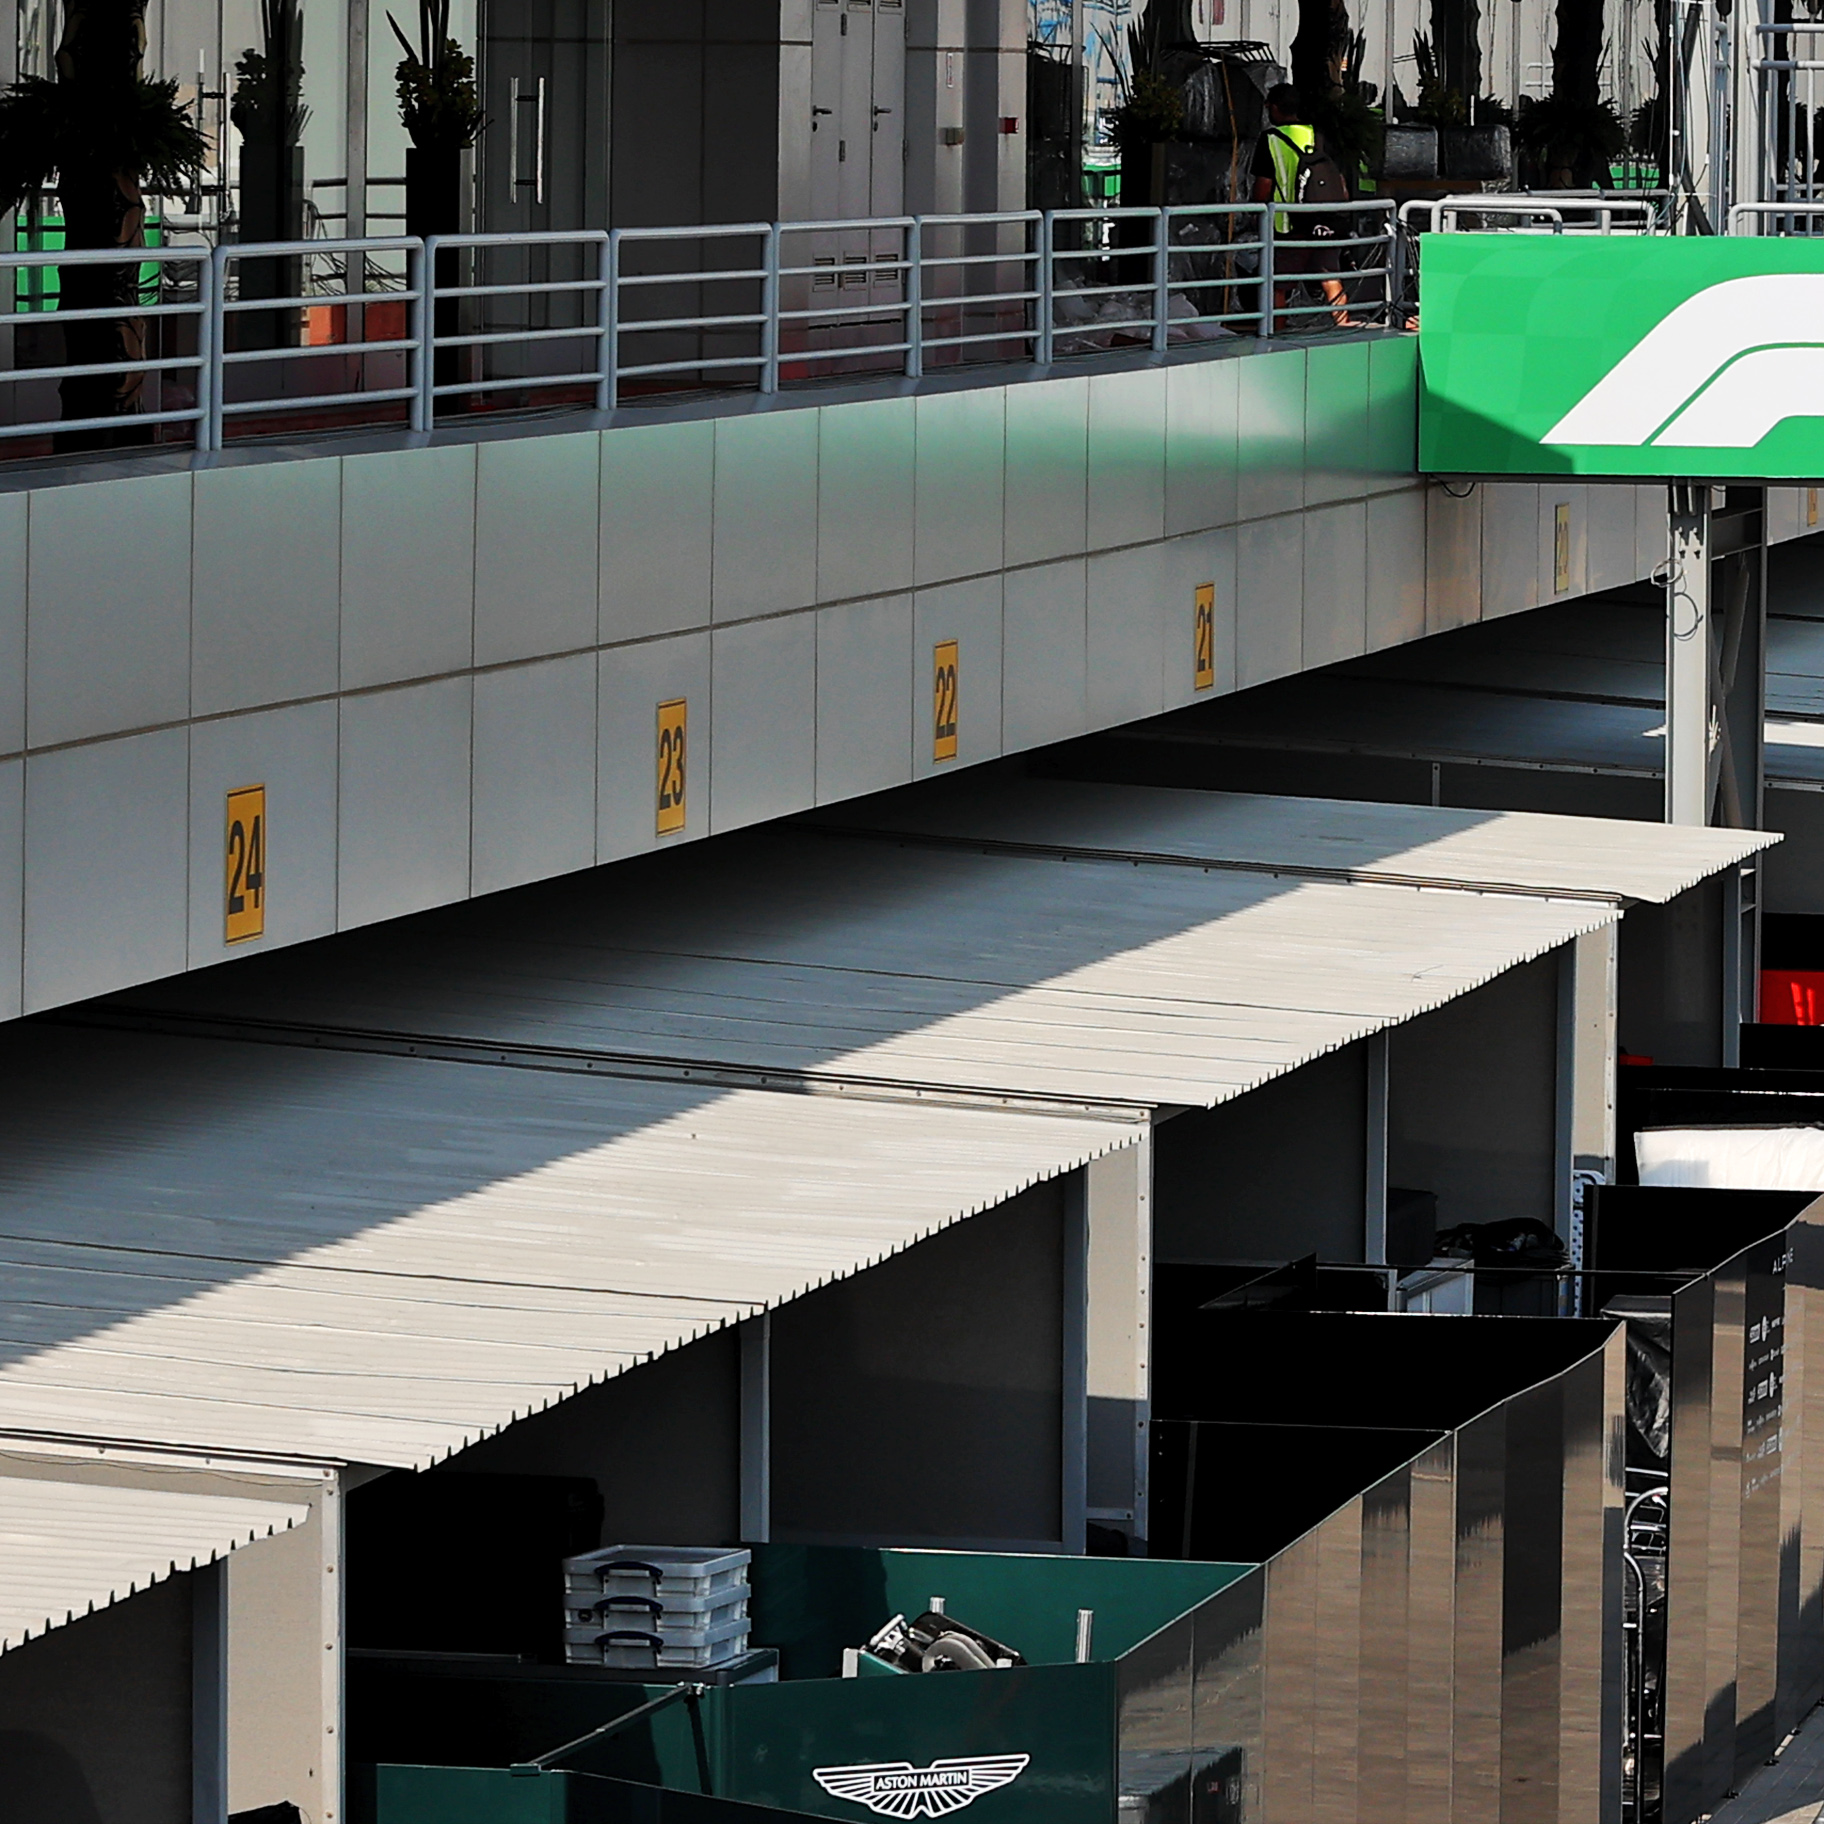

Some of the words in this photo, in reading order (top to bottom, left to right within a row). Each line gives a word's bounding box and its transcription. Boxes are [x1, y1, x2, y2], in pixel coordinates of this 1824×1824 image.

[1197, 601, 1212, 673] 21
[936, 663, 956, 740] 22
[659, 725, 684, 810] 23
[229, 814, 262, 915] 24
[876, 1774, 917, 1790] ASTON
[919, 1771, 968, 1787] MARTIN
